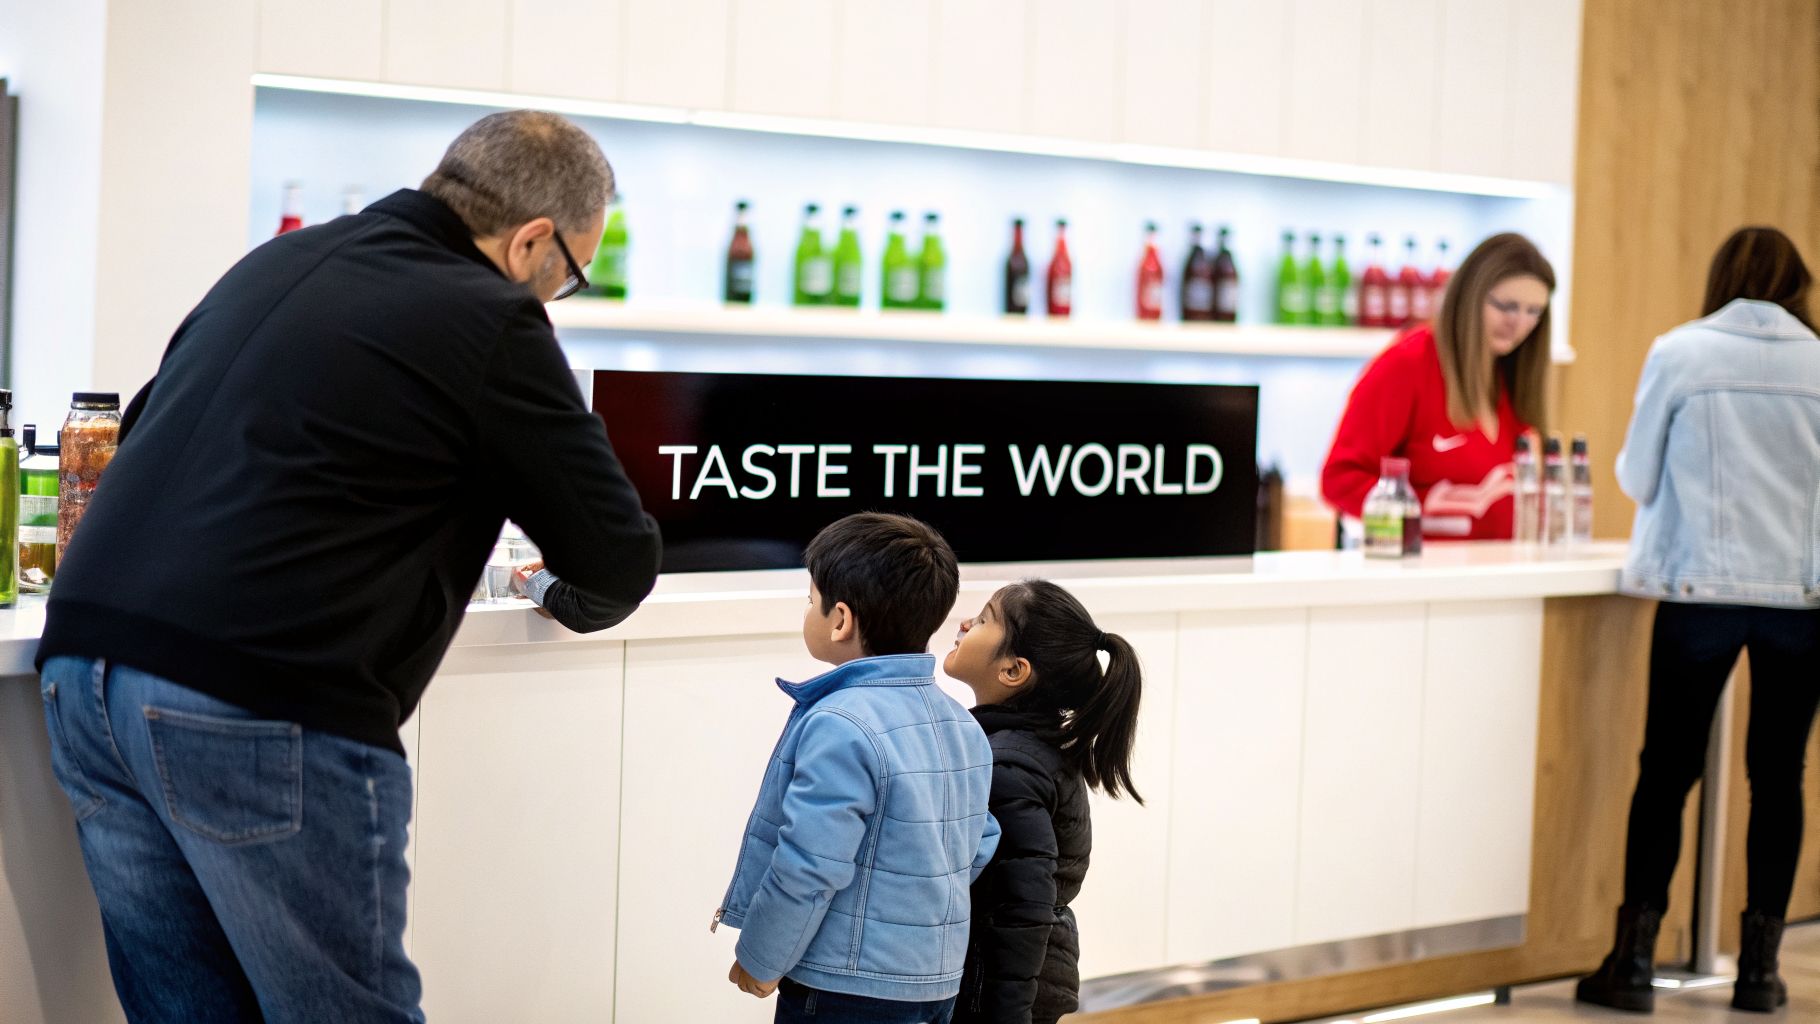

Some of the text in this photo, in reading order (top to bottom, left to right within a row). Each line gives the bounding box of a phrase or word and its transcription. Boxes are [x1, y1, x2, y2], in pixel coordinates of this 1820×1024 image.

[658, 443, 1223, 500] TASTE THE WORLD
